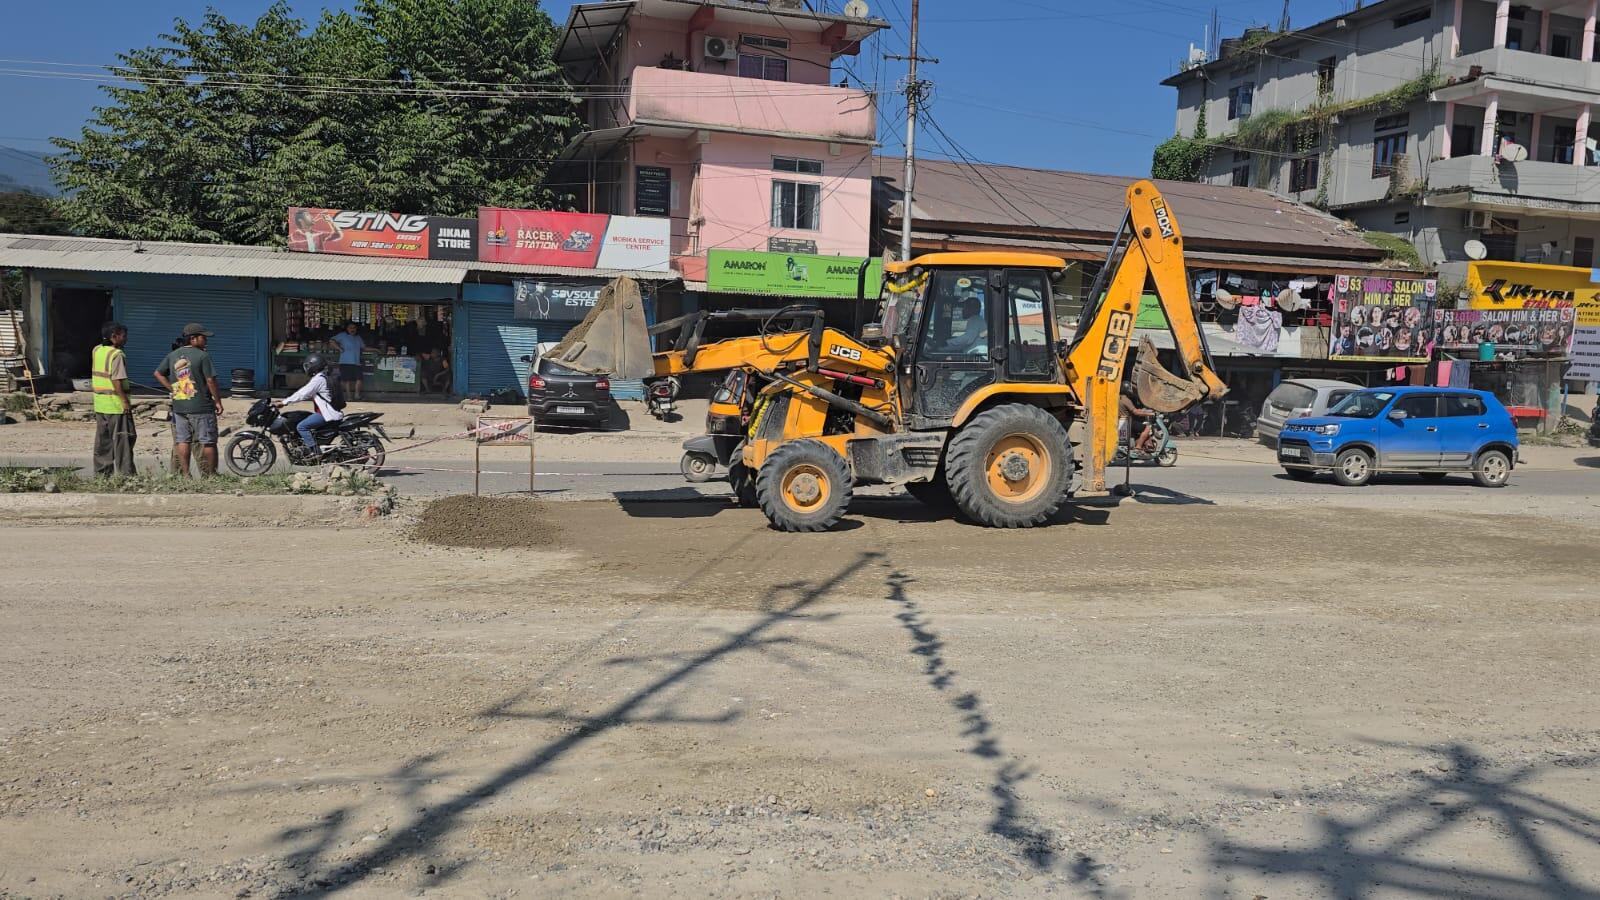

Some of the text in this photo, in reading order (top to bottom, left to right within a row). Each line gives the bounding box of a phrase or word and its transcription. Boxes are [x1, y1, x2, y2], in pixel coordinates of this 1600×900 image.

[333, 211, 429, 232] STING
[438, 228, 471, 239] JIKAM
[517, 229, 554, 241] RACER
[437, 238, 471, 249] STORE
[515, 240, 559, 250] STATION
[723, 260, 766, 271] AMARON
[825, 265, 860, 275] AMARO
[1350, 279, 1361, 292] S3
[1394, 281, 1424, 294] SALON
[1364, 293, 1411, 307] HIM & HER
[1482, 310, 1511, 321] SALON
[1511, 311, 1528, 321] HIM
[1540, 310, 1558, 322] HER
[1099, 312, 1132, 381] JCB
[831, 345, 862, 361] JCB
